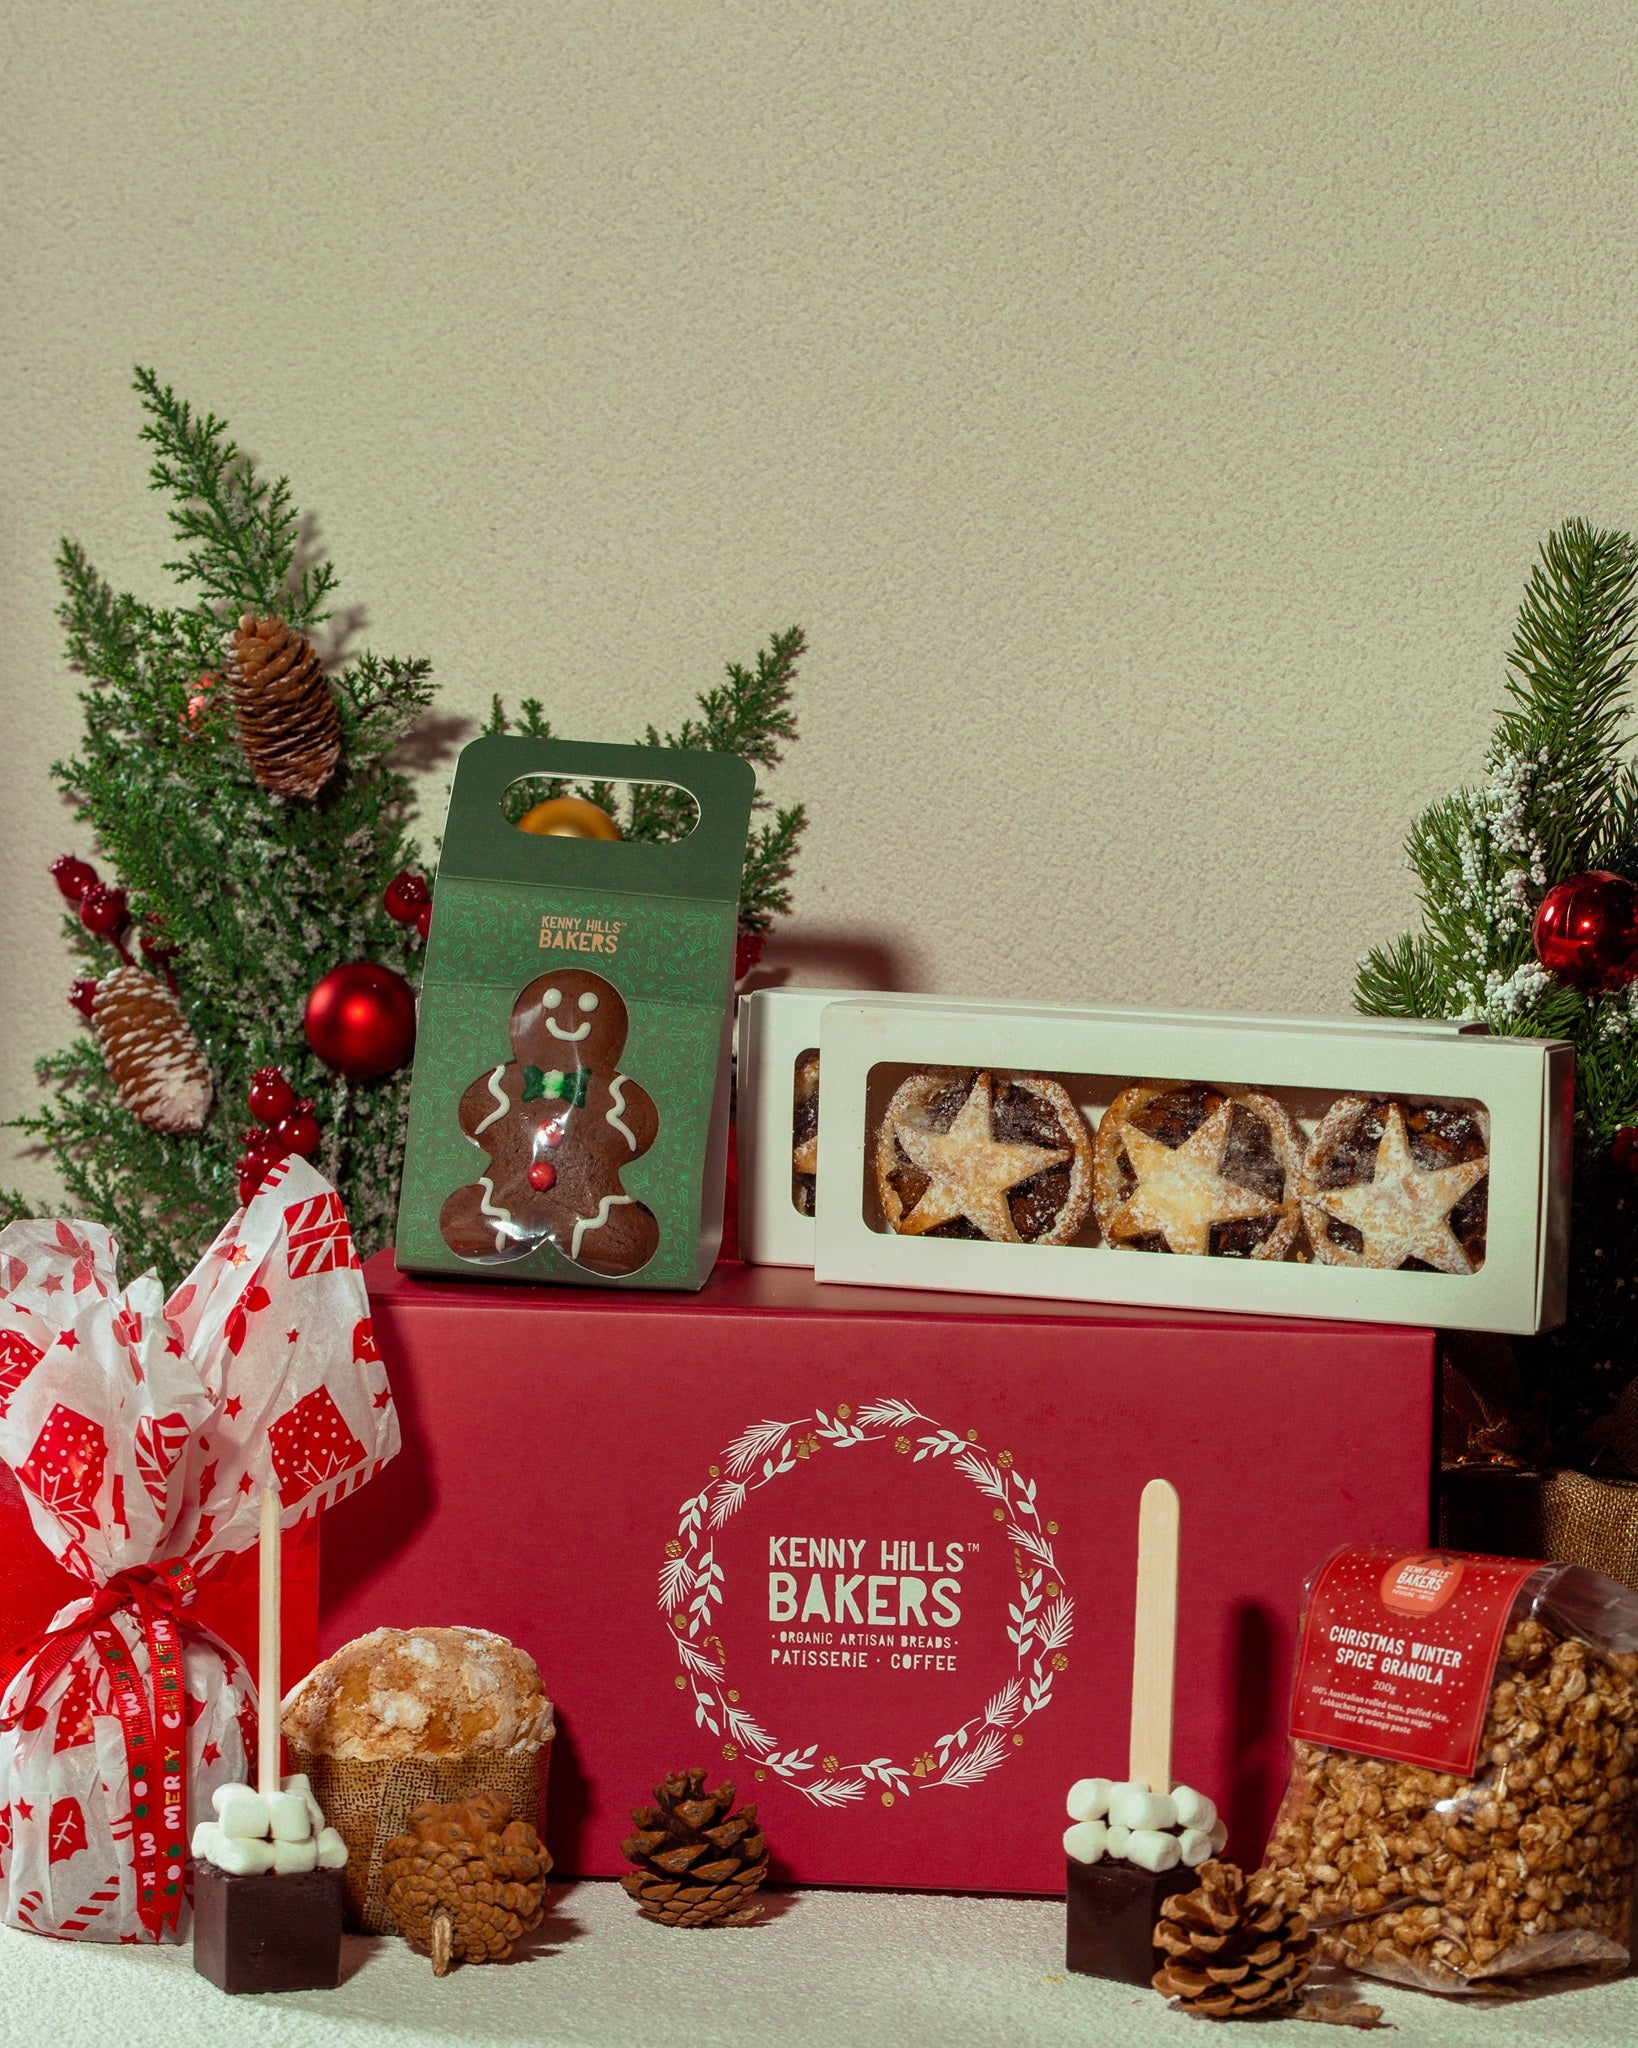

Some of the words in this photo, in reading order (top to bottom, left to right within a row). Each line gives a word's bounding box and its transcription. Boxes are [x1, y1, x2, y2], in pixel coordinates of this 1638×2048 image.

[541, 915, 581, 931] KENNY
[539, 929, 618, 954] BAKERS
[768, 1536, 866, 1569] KENNY
[1396, 1571, 1445, 1592] BAKERS
[1403, 1564, 1429, 1575] KENNY
[768, 1571, 962, 1628] BAKERS
[152, 1612, 182, 1729] CHRISTM
[890, 1653, 957, 1671] COFFEE
[1381, 1657, 1444, 1685] GRANOLA
[1372, 1680, 1396, 1696] 200g
[1320, 1697, 1356, 1712] Lebkuchen
[1357, 1706, 1385, 1719] powder,
[1386, 1712, 1409, 1723] brown
[1410, 1718, 1432, 1729] sugar,
[1328, 1689, 1364, 1703] Australian
[1365, 1698, 1387, 1709] rolled
[1387, 1703, 1405, 1713] oats,
[1406, 1707, 1432, 1719] puffed
[1432, 1712, 1449, 1723] rice,
[1334, 1710, 1357, 1722] butter
[1357, 1716, 1364, 1724] &
[1365, 1718, 1390, 1730] orange
[1390, 1724, 1412, 1734] paste
[162, 1746, 182, 1830] MERRY
[140, 1832, 157, 1914] MRRY
